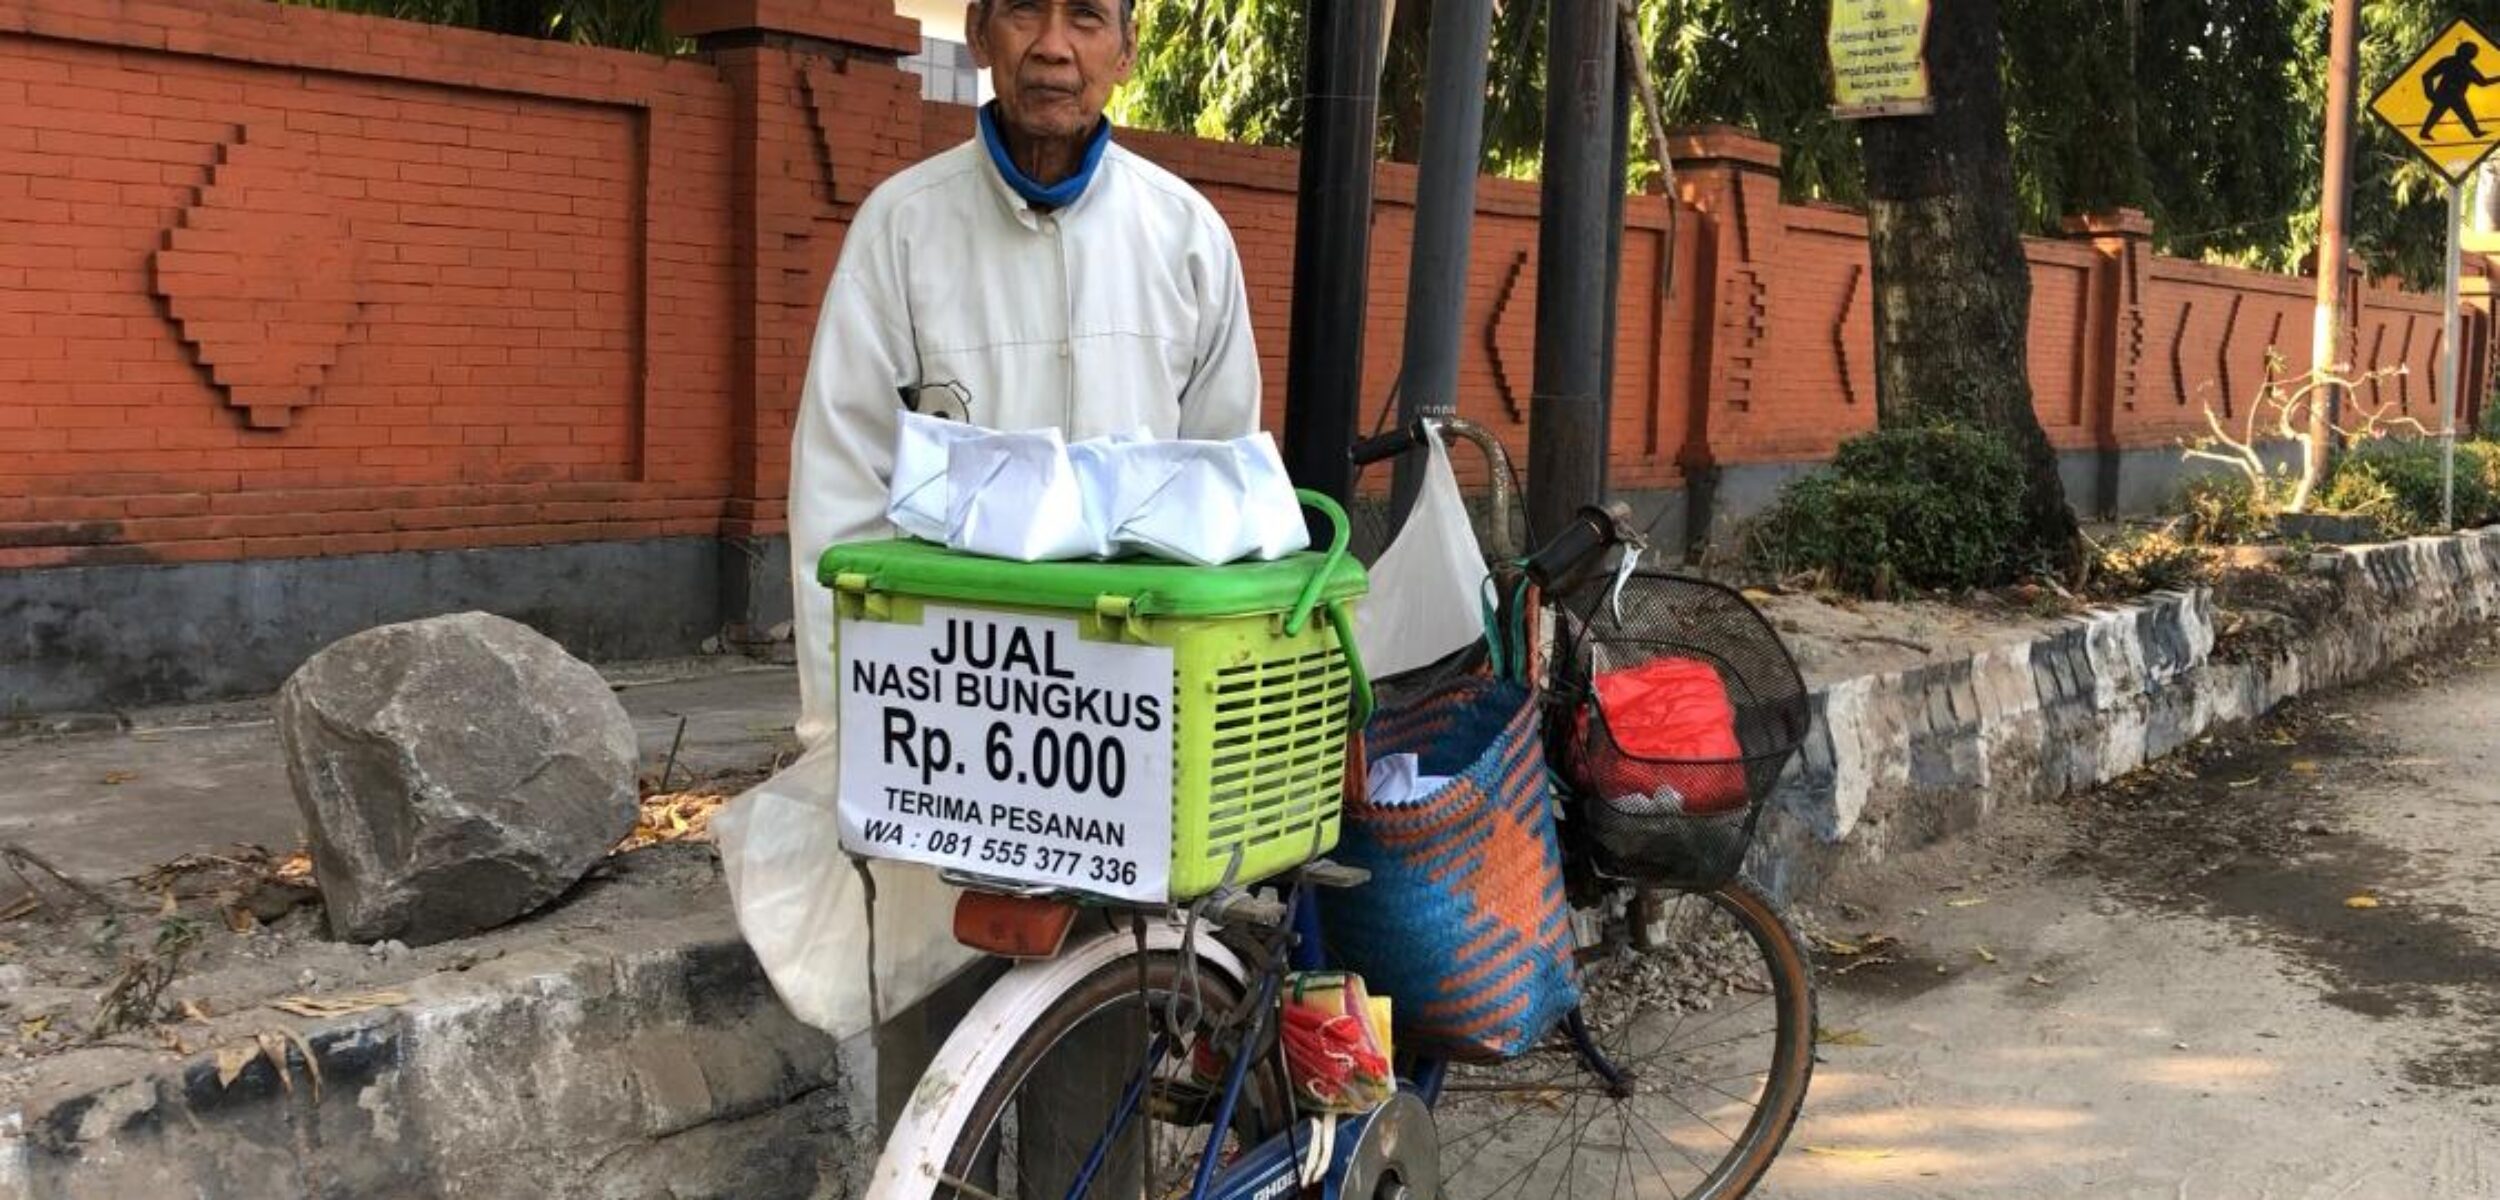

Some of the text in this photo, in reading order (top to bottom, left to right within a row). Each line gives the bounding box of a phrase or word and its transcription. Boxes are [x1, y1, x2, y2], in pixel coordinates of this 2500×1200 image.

[930, 618, 1075, 680] JUAL
[852, 659, 1161, 732] NASI BUNGKUS
[882, 706, 1126, 798] Rp. 6.000
[884, 787, 1126, 848] TERIMA PESANAN
[863, 818, 903, 846] WA
[927, 829, 973, 857] 081
[980, 842, 1028, 866] 555
[1034, 846, 1082, 877] 377
[1089, 858, 1138, 886] 336
